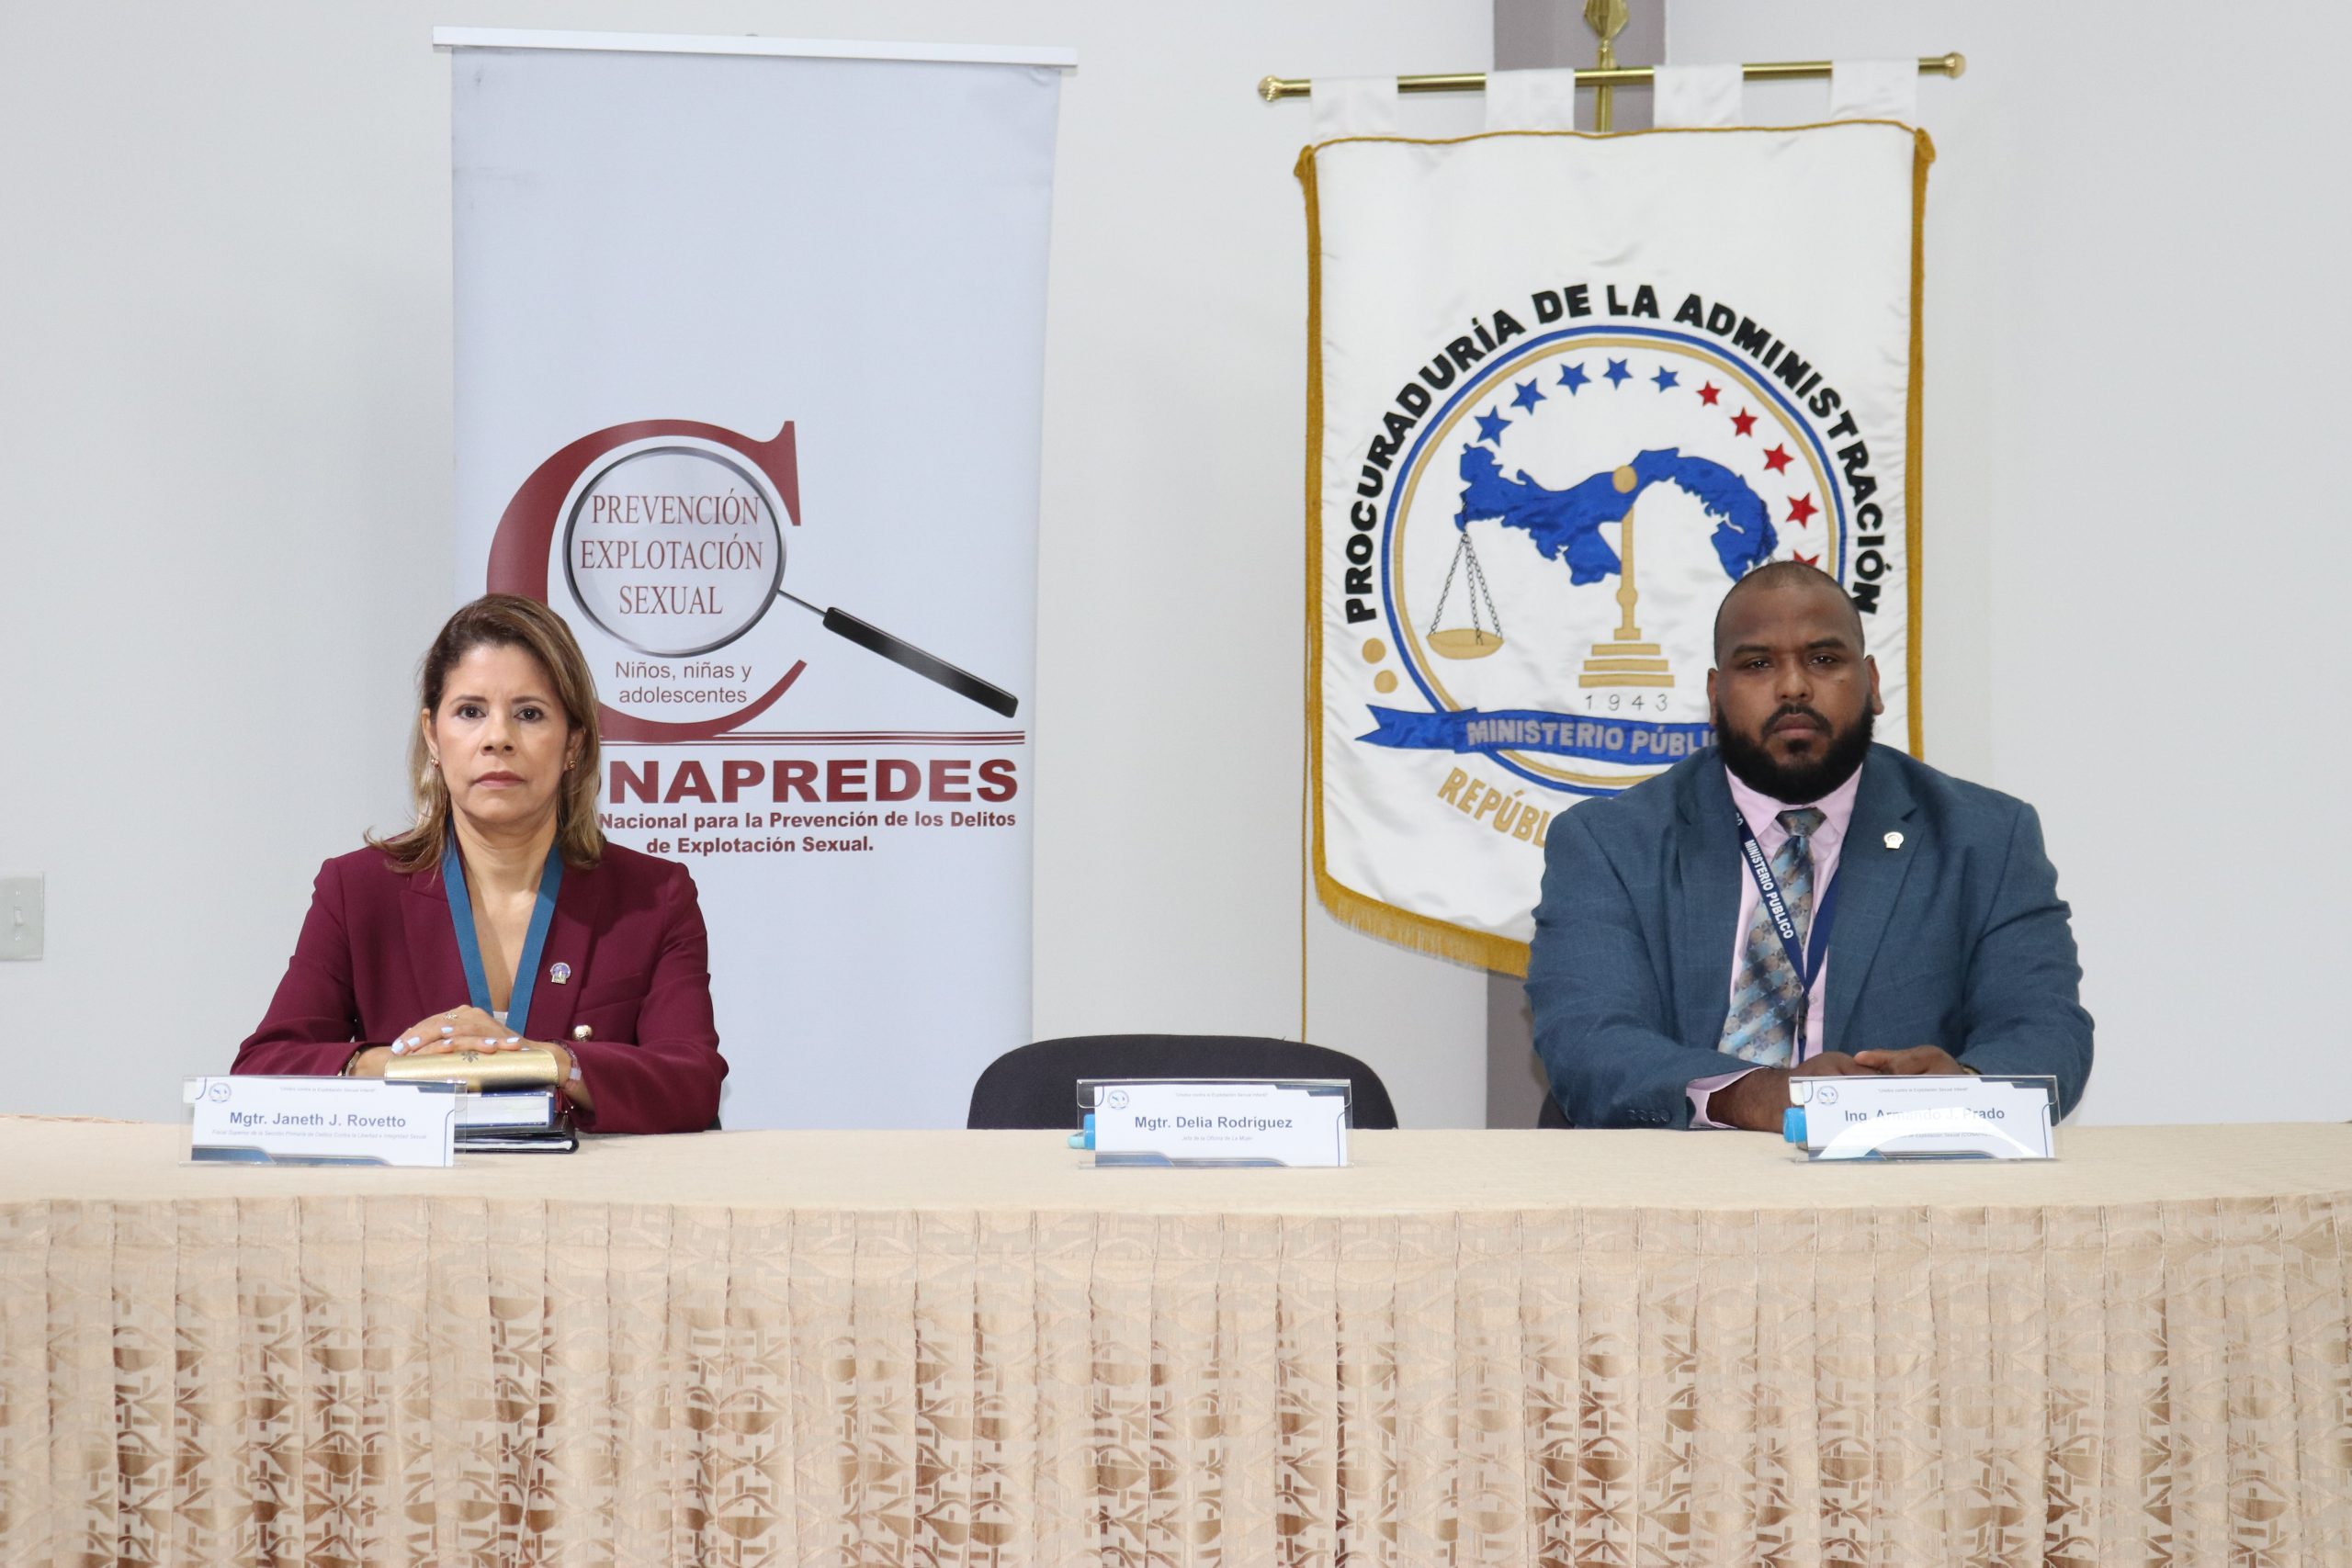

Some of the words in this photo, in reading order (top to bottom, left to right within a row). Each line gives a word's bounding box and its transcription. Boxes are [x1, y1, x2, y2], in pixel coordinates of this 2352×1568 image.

[1345, 310, 1527, 625] PROCURADURÍA
[1531, 283, 1592, 324] DE
[1606, 284, 1660, 320] LA
[1673, 293, 1893, 615] ADMINISTRACIÓN
[591, 487, 760, 525] PREVENCIÓN
[580, 533, 763, 570] EXPLOTACIÓN
[619, 585, 724, 615] SEXUAL
[615, 661, 676, 682] Niños,
[684, 661, 735, 679] niñas
[741, 666, 752, 683] y
[618, 686, 747, 704] adolescentes
[1465, 718, 1624, 750] MINISTERIO
[609, 758, 1019, 805] NAPREDES
[599, 812, 687, 829] Nacional
[694, 815, 737, 832] para
[744, 812, 763, 829] la
[770, 811, 877, 829] Prevención
[885, 811, 907, 827] de
[914, 811, 944, 827] los
[951, 811, 1017, 827] Delitos
[646, 837, 671, 853] de
[677, 836, 796, 857] Explotación
[802, 835, 875, 852] Sexual.
[1744, 840, 1775, 891] MINISTERIO
[1765, 891, 1794, 940] PUBLICO
[230, 1111, 267, 1127] Mgtr.
[272, 1112, 324, 1126] Janeth
[328, 1113, 343, 1127] J.
[347, 1113, 407, 1128] Rovetto
[1135, 1115, 1171, 1132] Mgtr.
[1176, 1115, 1213, 1129] Delia
